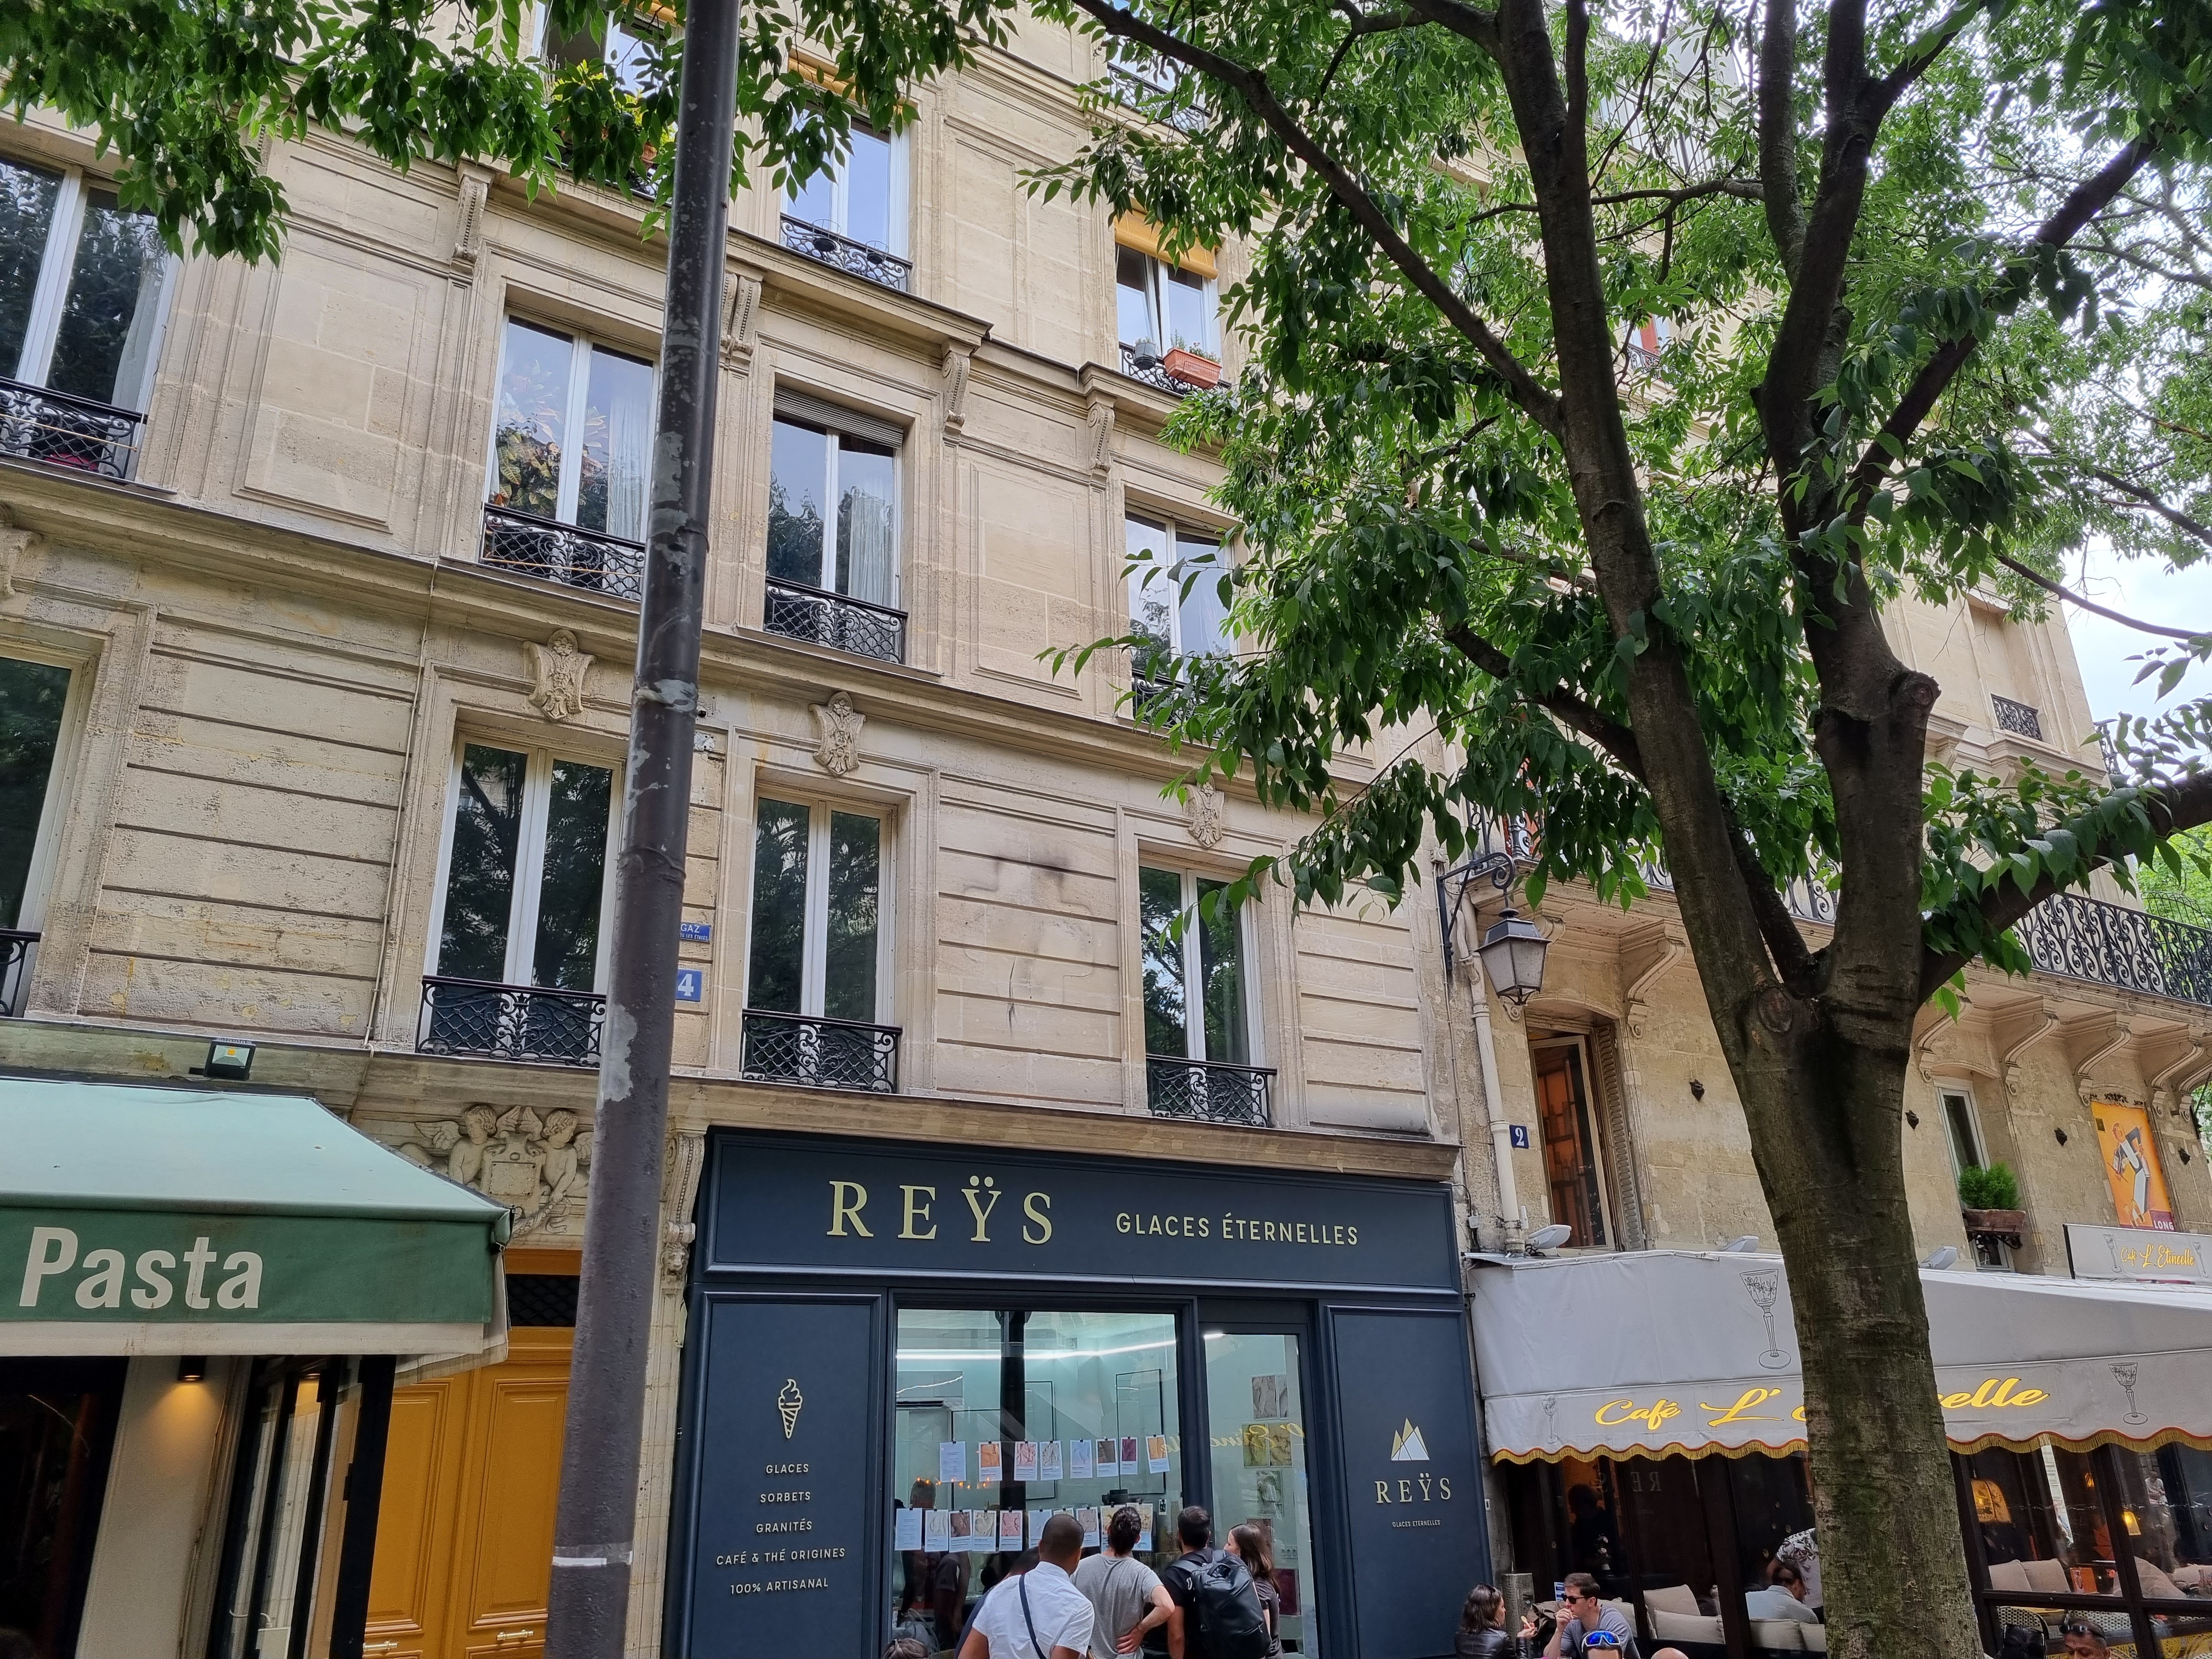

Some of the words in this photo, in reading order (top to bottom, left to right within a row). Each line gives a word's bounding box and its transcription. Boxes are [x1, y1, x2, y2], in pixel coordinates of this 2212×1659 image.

[680, 923, 700, 933] GAZ
[678, 973, 695, 997] 4
[1515, 1127, 1525, 1146] 2
[826, 1175, 1052, 1244] REŸS
[1116, 1212, 1209, 1237] GLACES
[1222, 1212, 1358, 1245] ÉTERNELLES
[19, 1226, 263, 1310] Pasta
[1594, 1398, 1681, 1430] Café
[1700, 1388, 1784, 1427] L'
[766, 1463, 809, 1474] GLACES
[760, 1491, 811, 1503] SORBETS
[1374, 1472, 1451, 1504] REŸS
[756, 1518, 812, 1533] GRANITÉS
[716, 1550, 747, 1565] CAFÉ
[752, 1553, 759, 1562] &
[764, 1548, 786, 1562] THÉ
[791, 1548, 845, 1561] ORIGINES
[730, 1583, 761, 1594] 100%
[766, 1577, 829, 1592] ARTISANAL
